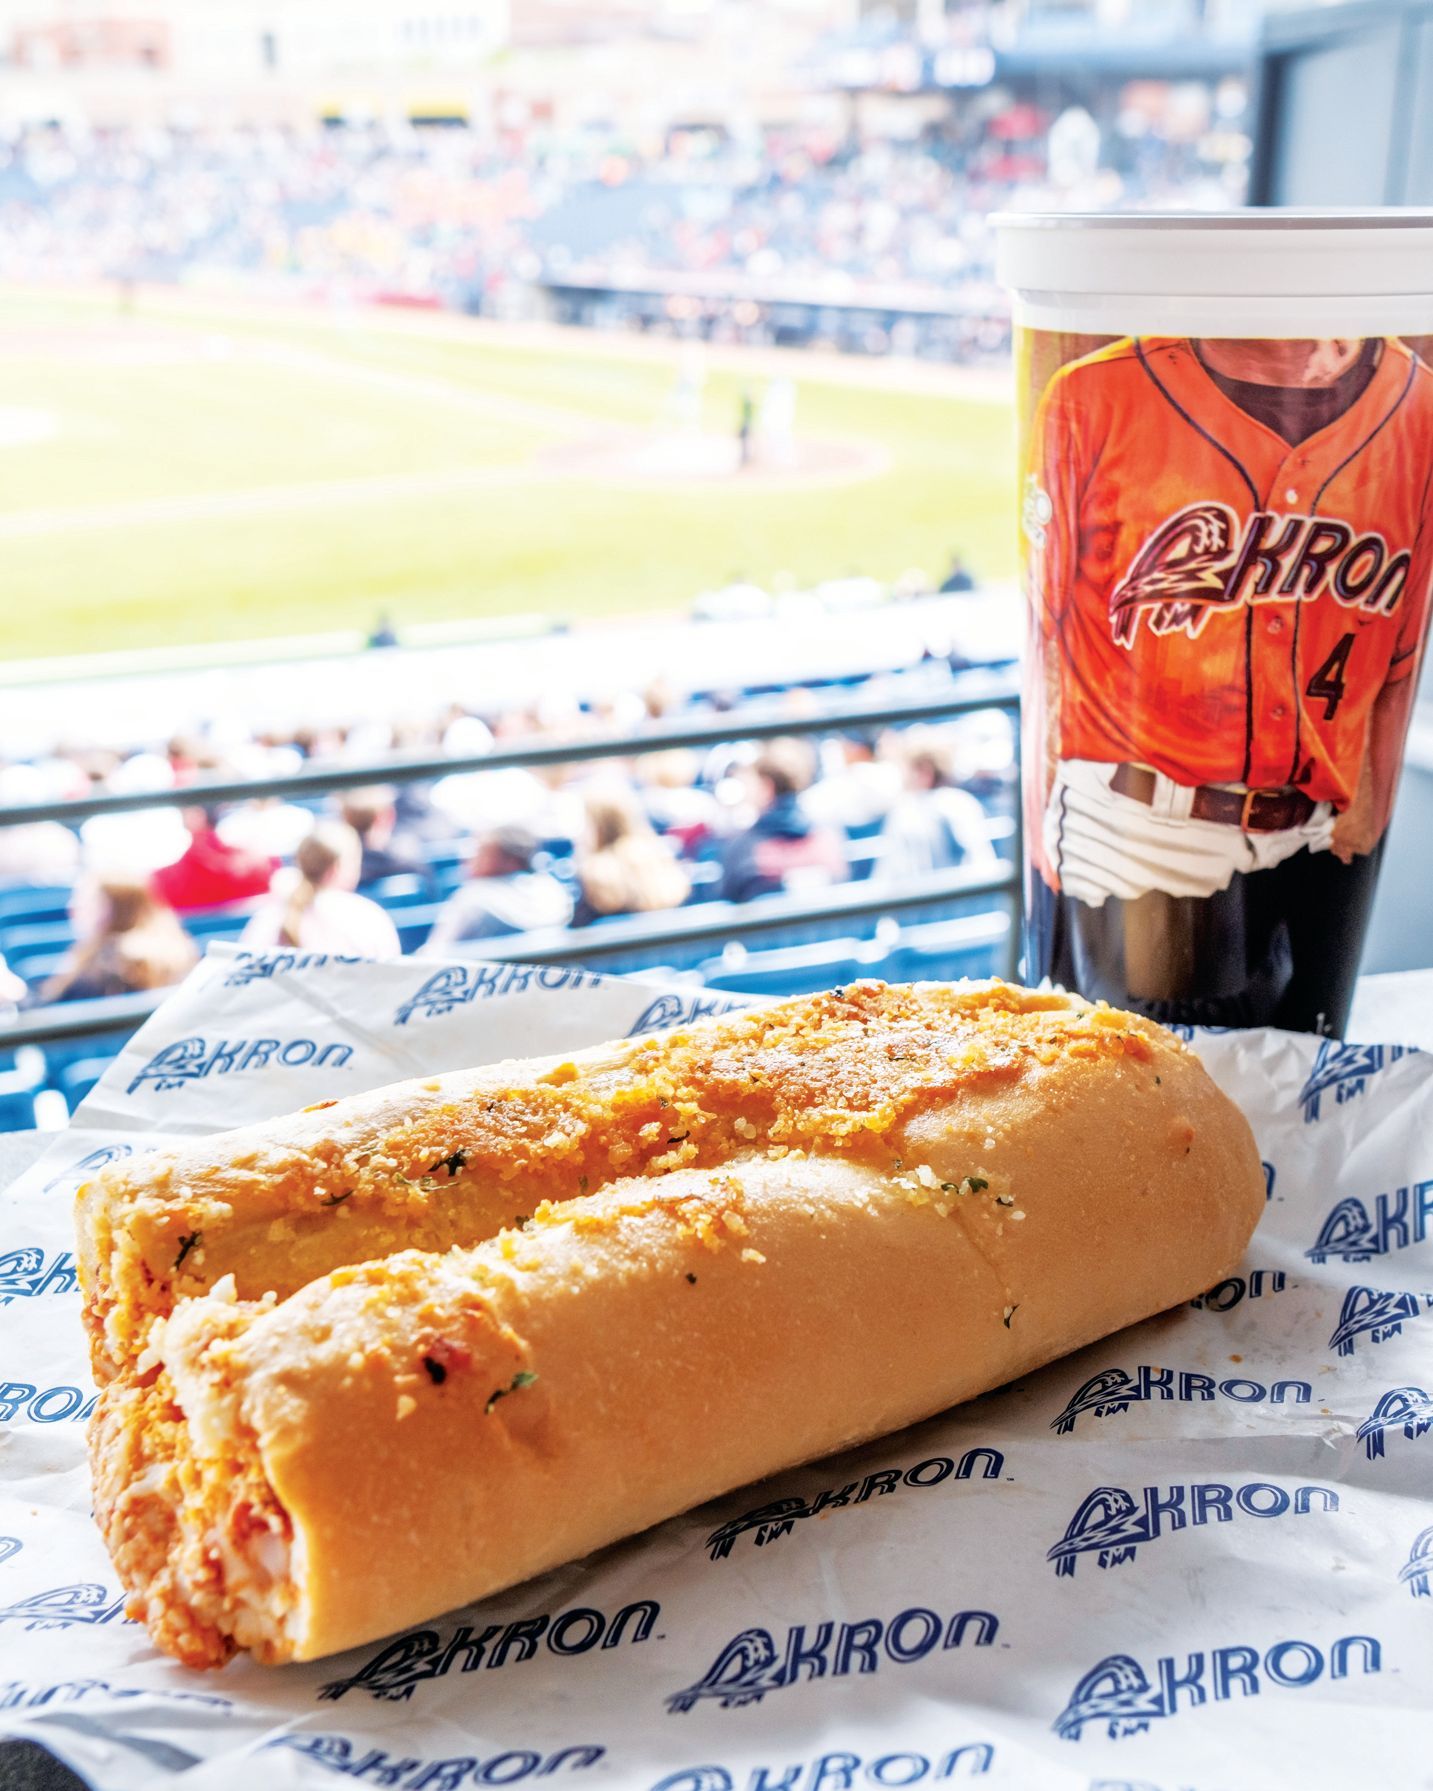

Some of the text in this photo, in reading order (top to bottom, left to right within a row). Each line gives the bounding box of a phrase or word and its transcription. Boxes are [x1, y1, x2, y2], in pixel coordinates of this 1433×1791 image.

[1110, 503, 1411, 648] AKRON
[1306, 633, 1356, 720] 4
[126, 1037, 354, 1095] AKRON
[1049, 1365, 1312, 1435] AKRON
[705, 1448, 1004, 1560] AKRON
[1046, 1482, 1340, 1577] AKRON
[316, 1600, 661, 1701] AKRON
[664, 1608, 999, 1715] AKRON
[1051, 1635, 1382, 1741] AKRON
